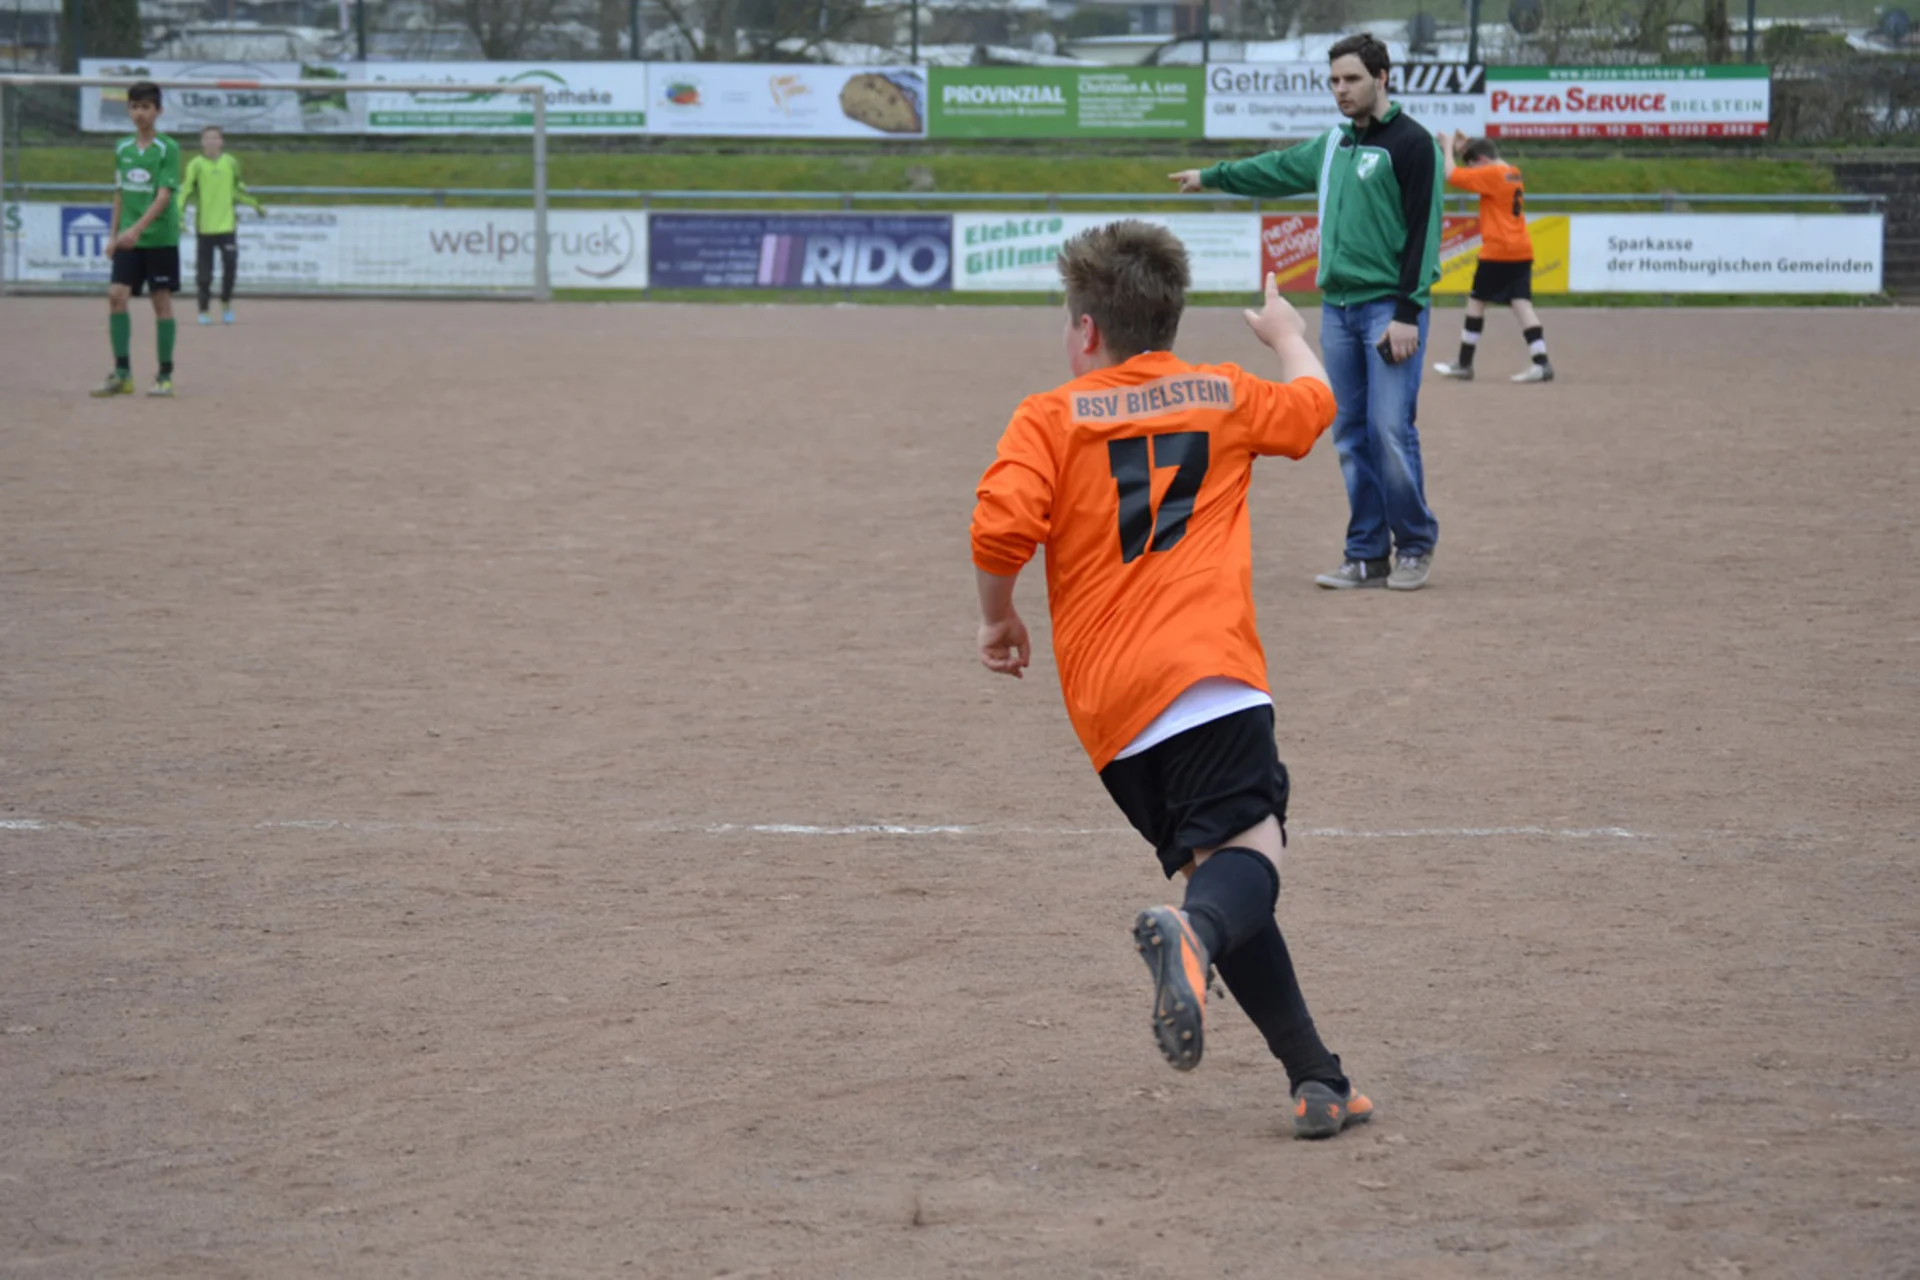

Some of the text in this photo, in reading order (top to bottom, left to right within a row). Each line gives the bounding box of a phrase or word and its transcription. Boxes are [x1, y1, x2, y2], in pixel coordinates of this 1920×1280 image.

[1388, 64, 1484, 94] AULY
[518, 87, 613, 106] Aotheke
[942, 85, 1067, 105] PROVINZIAL
[1248, 102, 1337, 118] Dieringhause
[1490, 86, 1763, 113] PIZZA SERVICE BIELSTEIN
[1512, 187, 1523, 218] 6
[964, 216, 1063, 246] Elektro
[1607, 236, 1693, 253] Sparkasse
[801, 234, 949, 288] RIDO
[964, 243, 1061, 276] Gillme
[1607, 257, 1873, 276] der Homburgischen Gemeinden
[1076, 379, 1230, 417] BSV BIELSTEIN
[1107, 431, 1210, 564] 17
